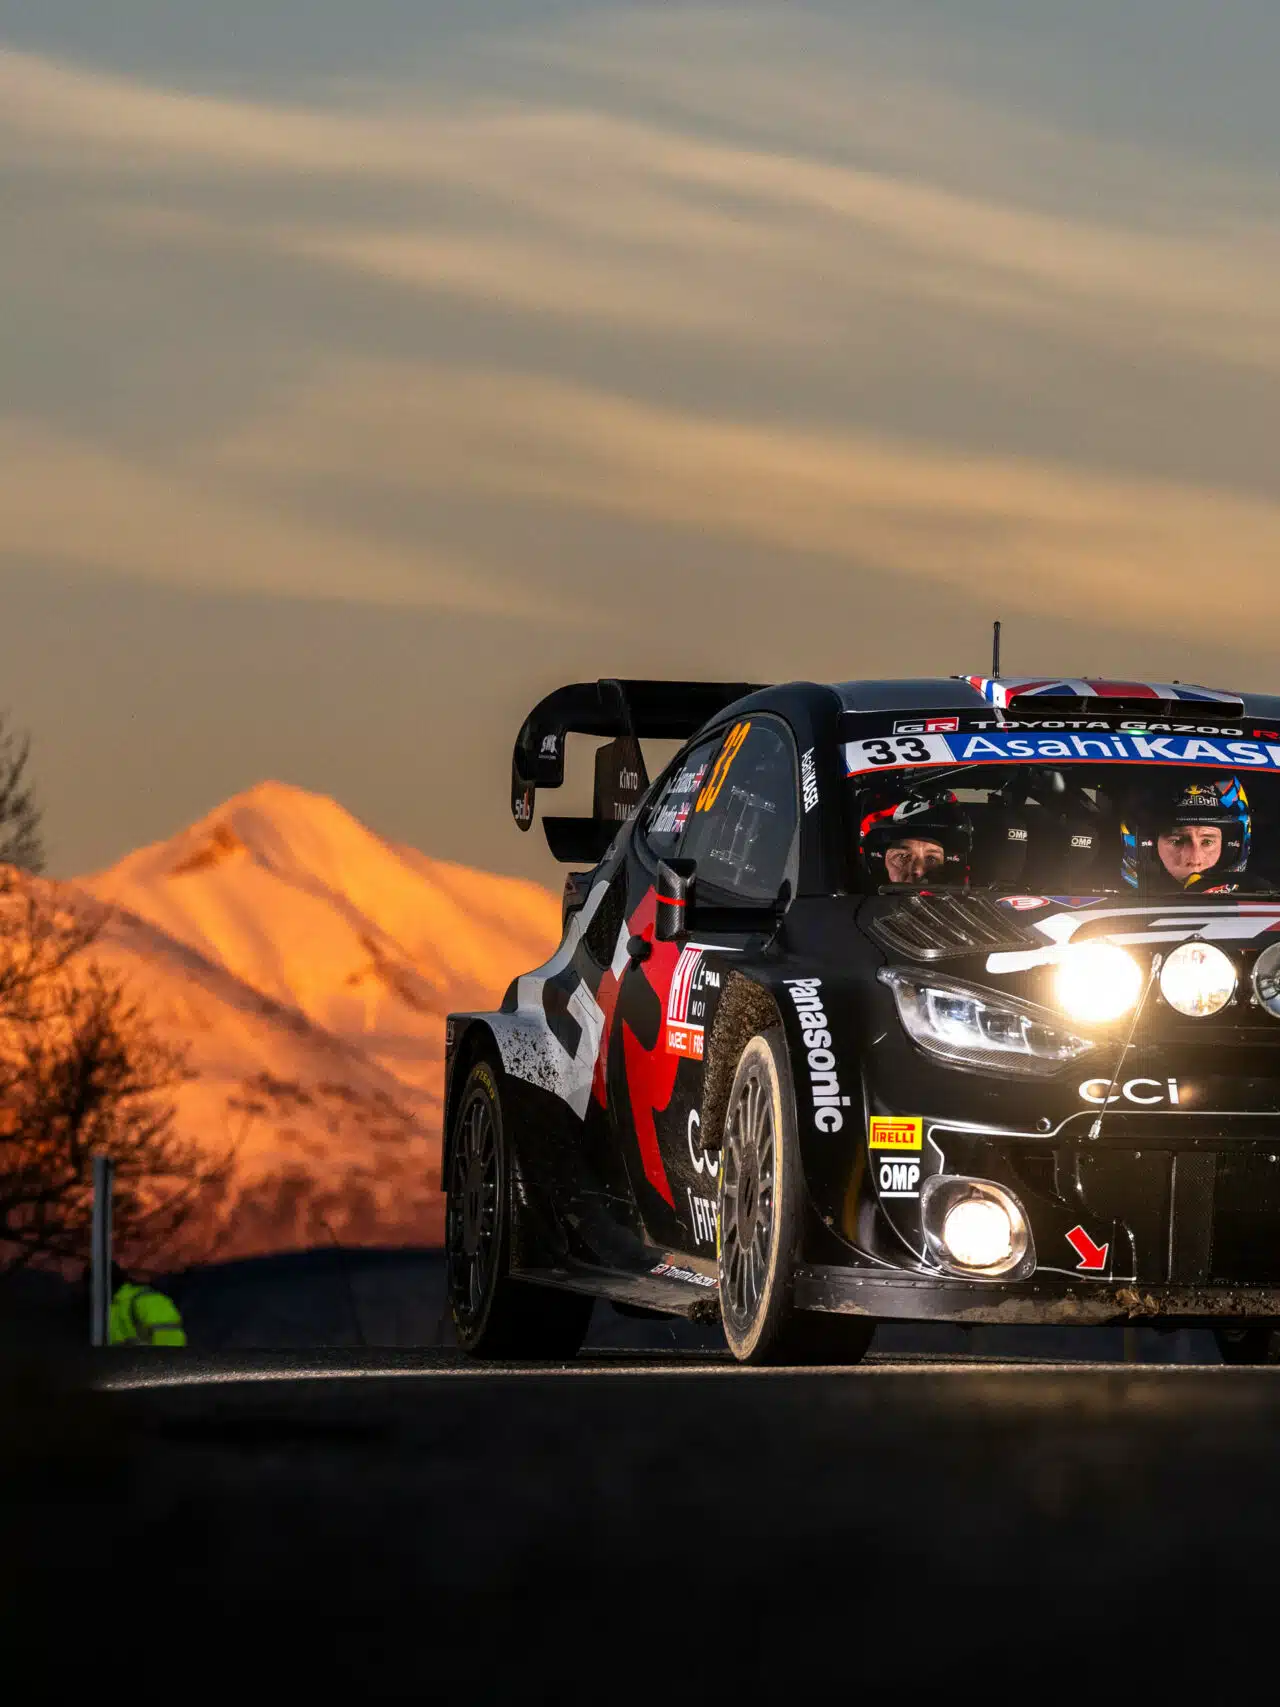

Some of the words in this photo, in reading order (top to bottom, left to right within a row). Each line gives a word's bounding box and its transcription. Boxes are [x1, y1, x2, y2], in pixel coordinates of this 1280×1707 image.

[895, 720, 957, 733] GR
[970, 720, 1110, 729] TOYOTA
[1120, 721, 1244, 736] GAZOO
[862, 737, 931, 765] 33
[695, 722, 751, 812] 33
[1008, 830, 1028, 839] OMP
[1071, 837, 1092, 847] OMP
[705, 971, 720, 988] PIAA
[783, 978, 851, 1133] Panasonic
[873, 1123, 915, 1143] PIRELLI
[880, 1163, 920, 1191] OMP
